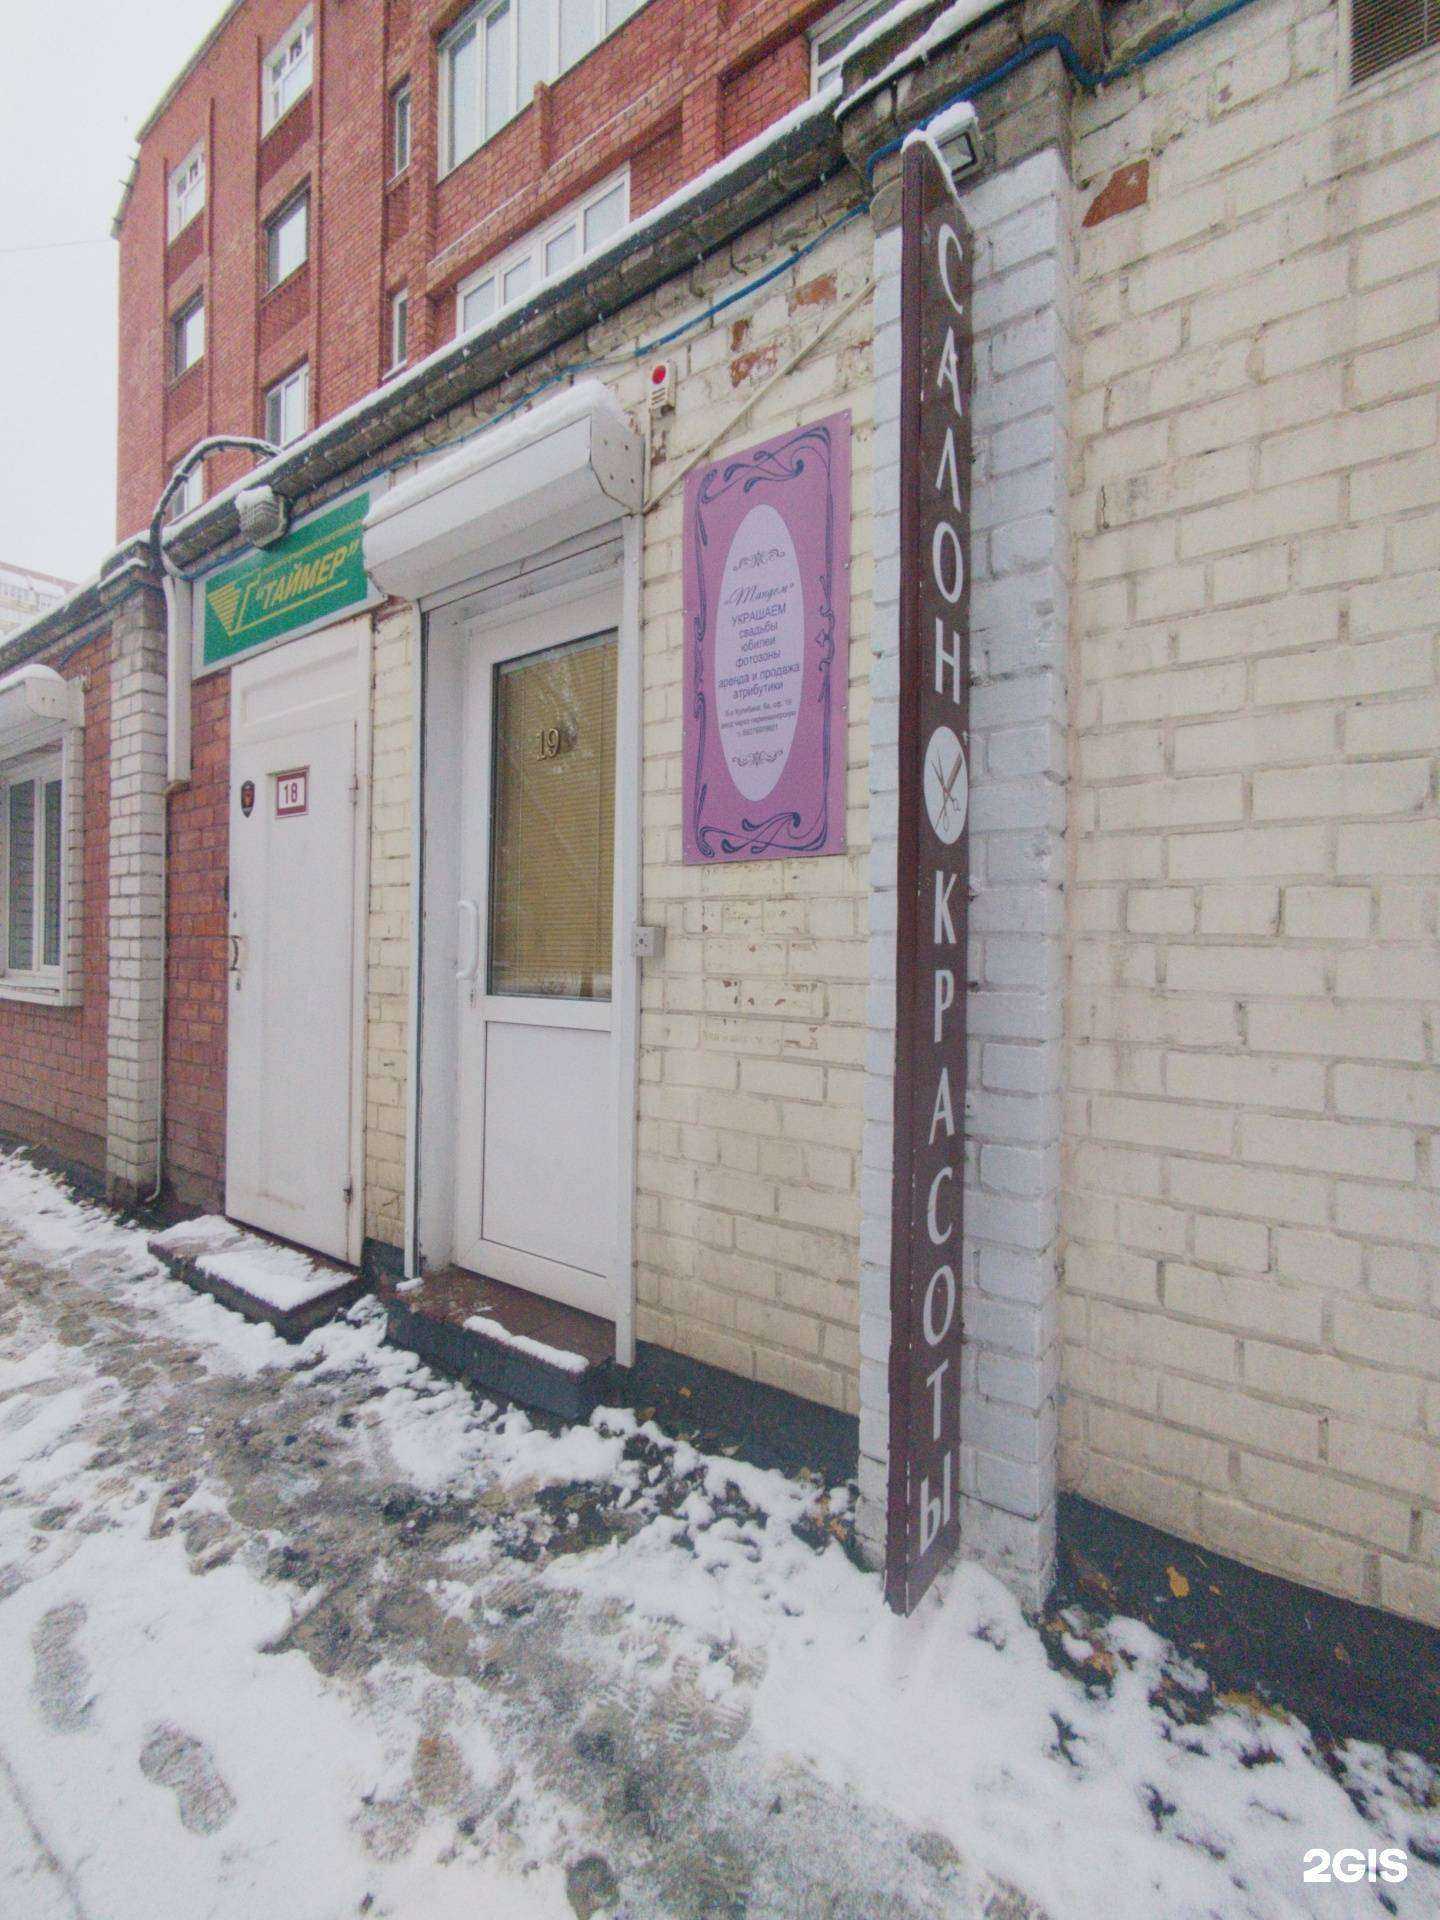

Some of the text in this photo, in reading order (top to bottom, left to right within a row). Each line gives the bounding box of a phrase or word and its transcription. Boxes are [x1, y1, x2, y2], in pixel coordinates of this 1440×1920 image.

[932, 223, 964, 705] САЛОН
[731, 602, 786, 627] УКРАШАЕМ
[738, 620, 778, 639] свадьбы
[735, 649, 782, 668] фотозоны
[718, 673, 749, 688] аренда
[760, 662, 800, 681] продажа
[733, 681, 784, 700] атрибутики
[535, 728, 561, 761] 19
[284, 782, 298, 804] 18
[919, 870, 957, 1556] КРАСОТЫ
